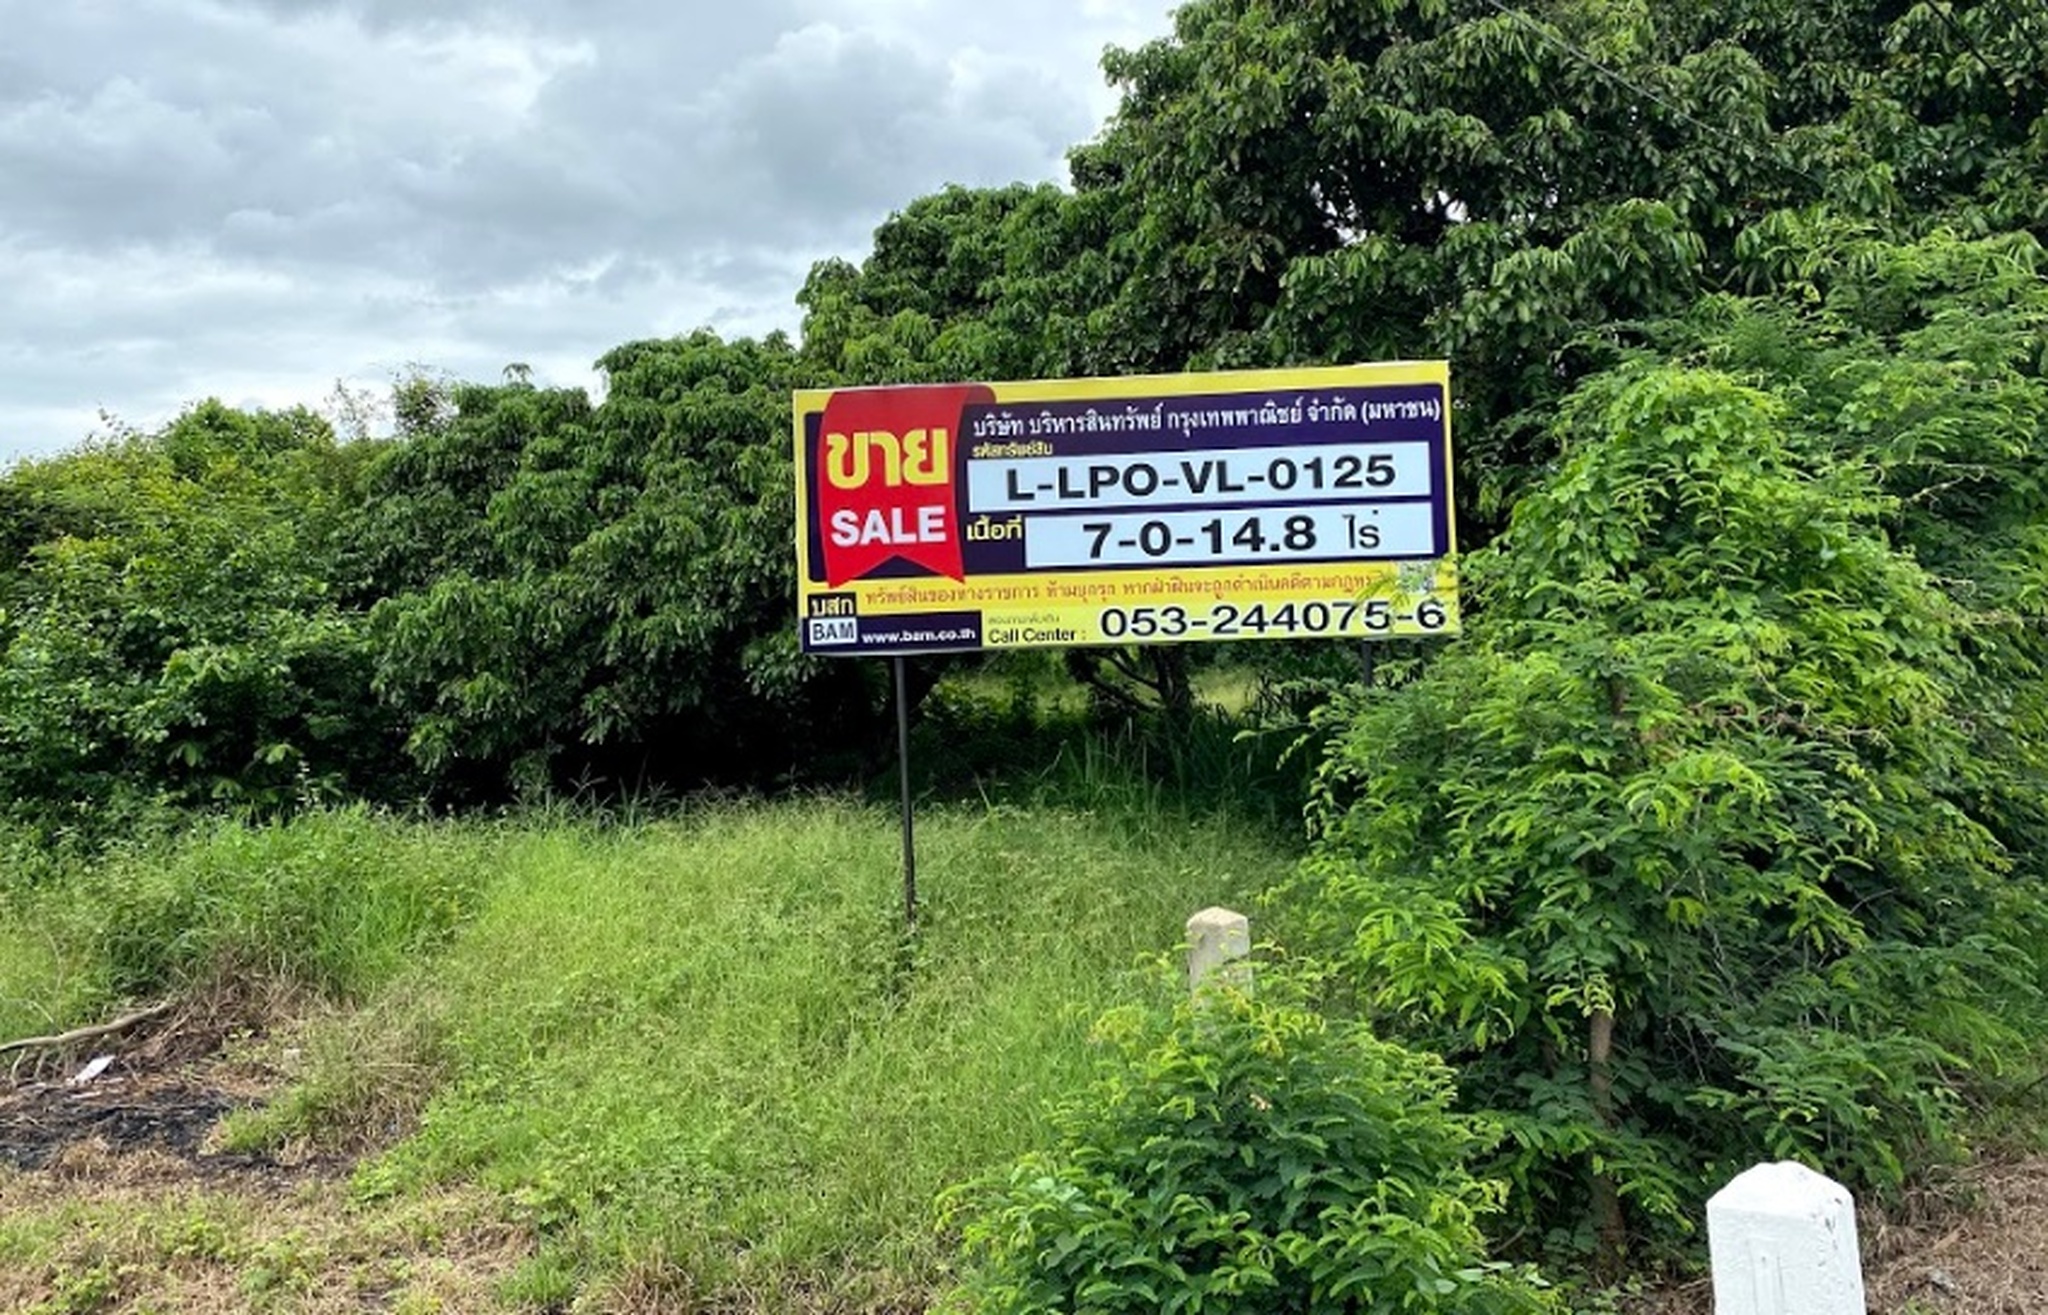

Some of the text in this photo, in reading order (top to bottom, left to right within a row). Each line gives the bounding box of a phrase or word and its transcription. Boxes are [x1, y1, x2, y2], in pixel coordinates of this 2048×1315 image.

[974, 397, 1441, 437] บริษัท บริหารสินทรัพย์ กรุงเทพพาณิชย์ จำกัด (มหาชน)
[826, 428, 949, 490] ขาย
[1006, 454, 1397, 501] L-LPO-VL-0125
[831, 505, 947, 547] SALE
[966, 509, 1381, 559] เนื้อที่ 7-0-14.8 ไร่
[812, 621, 855, 641] BAM
[861, 628, 977, 644] www.bam.co.th
[988, 628, 1019, 644] Call
[1022, 628, 1076, 642] Center
[1101, 599, 1447, 637] 053-244075-6
